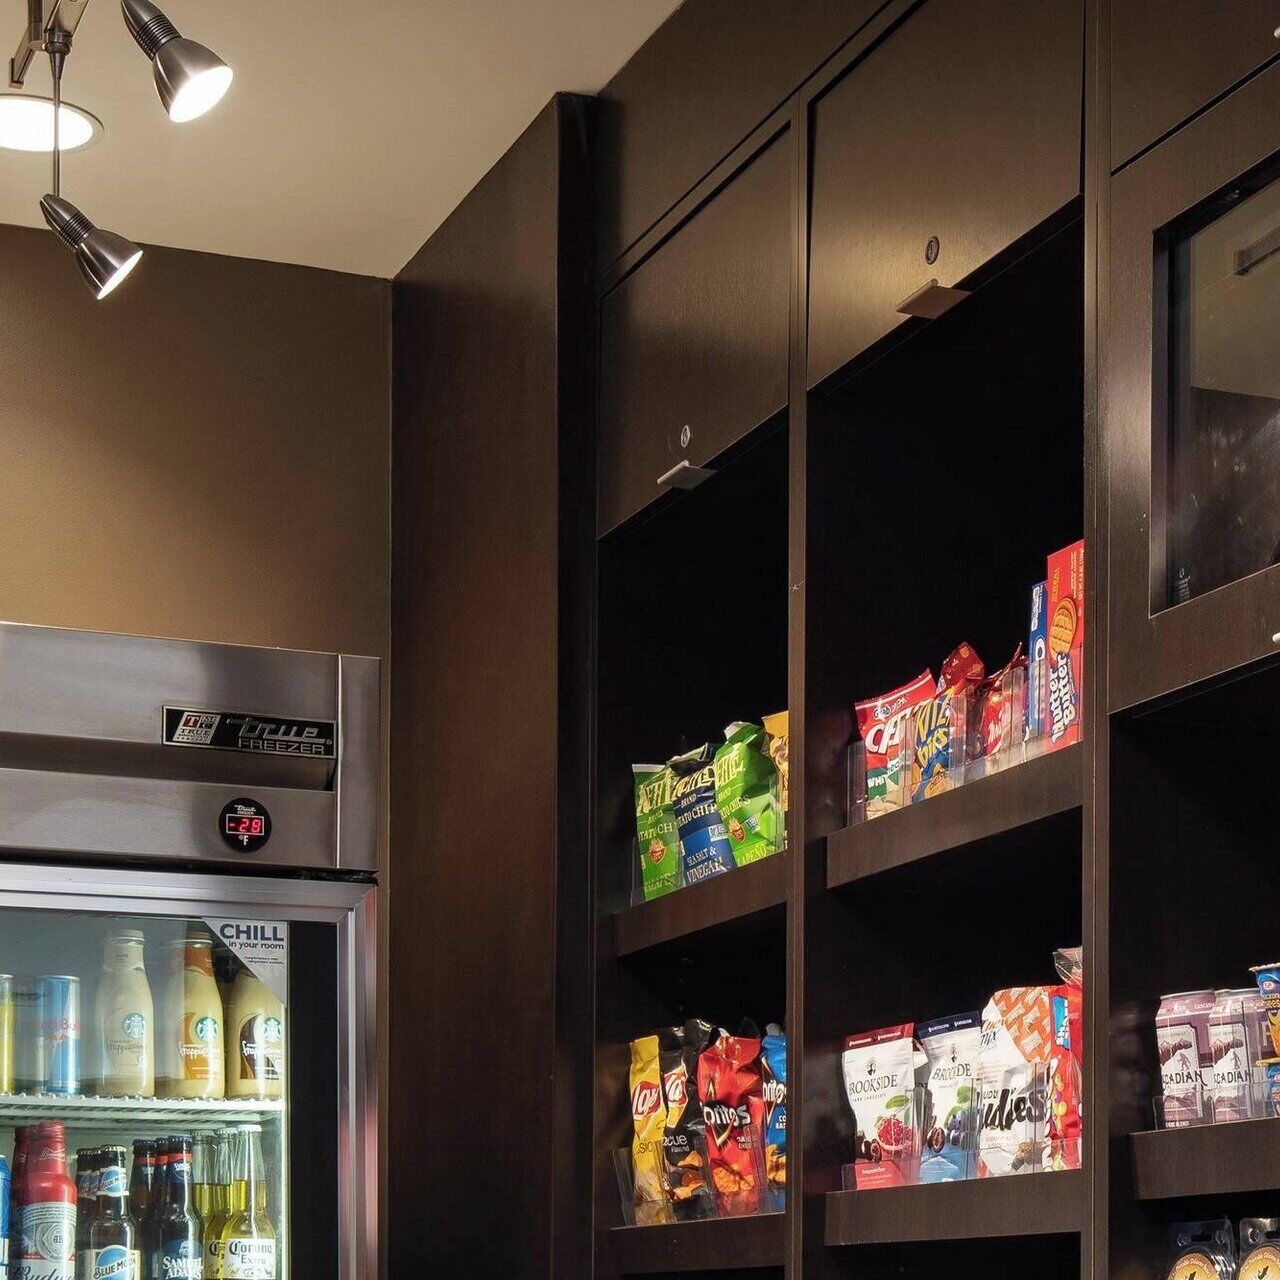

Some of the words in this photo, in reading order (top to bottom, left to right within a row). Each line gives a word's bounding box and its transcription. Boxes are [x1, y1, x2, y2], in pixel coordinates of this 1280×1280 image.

[238, 737, 325, 755] FREEZER
[220, 923, 284, 941] CHILL
[229, 940, 237, 948] in
[238, 942, 259, 950] your
[849, 1074, 898, 1097] ROOKSIDE
[704, 1105, 752, 1127] oritos
[94, 1263, 115, 1280] BLUE
